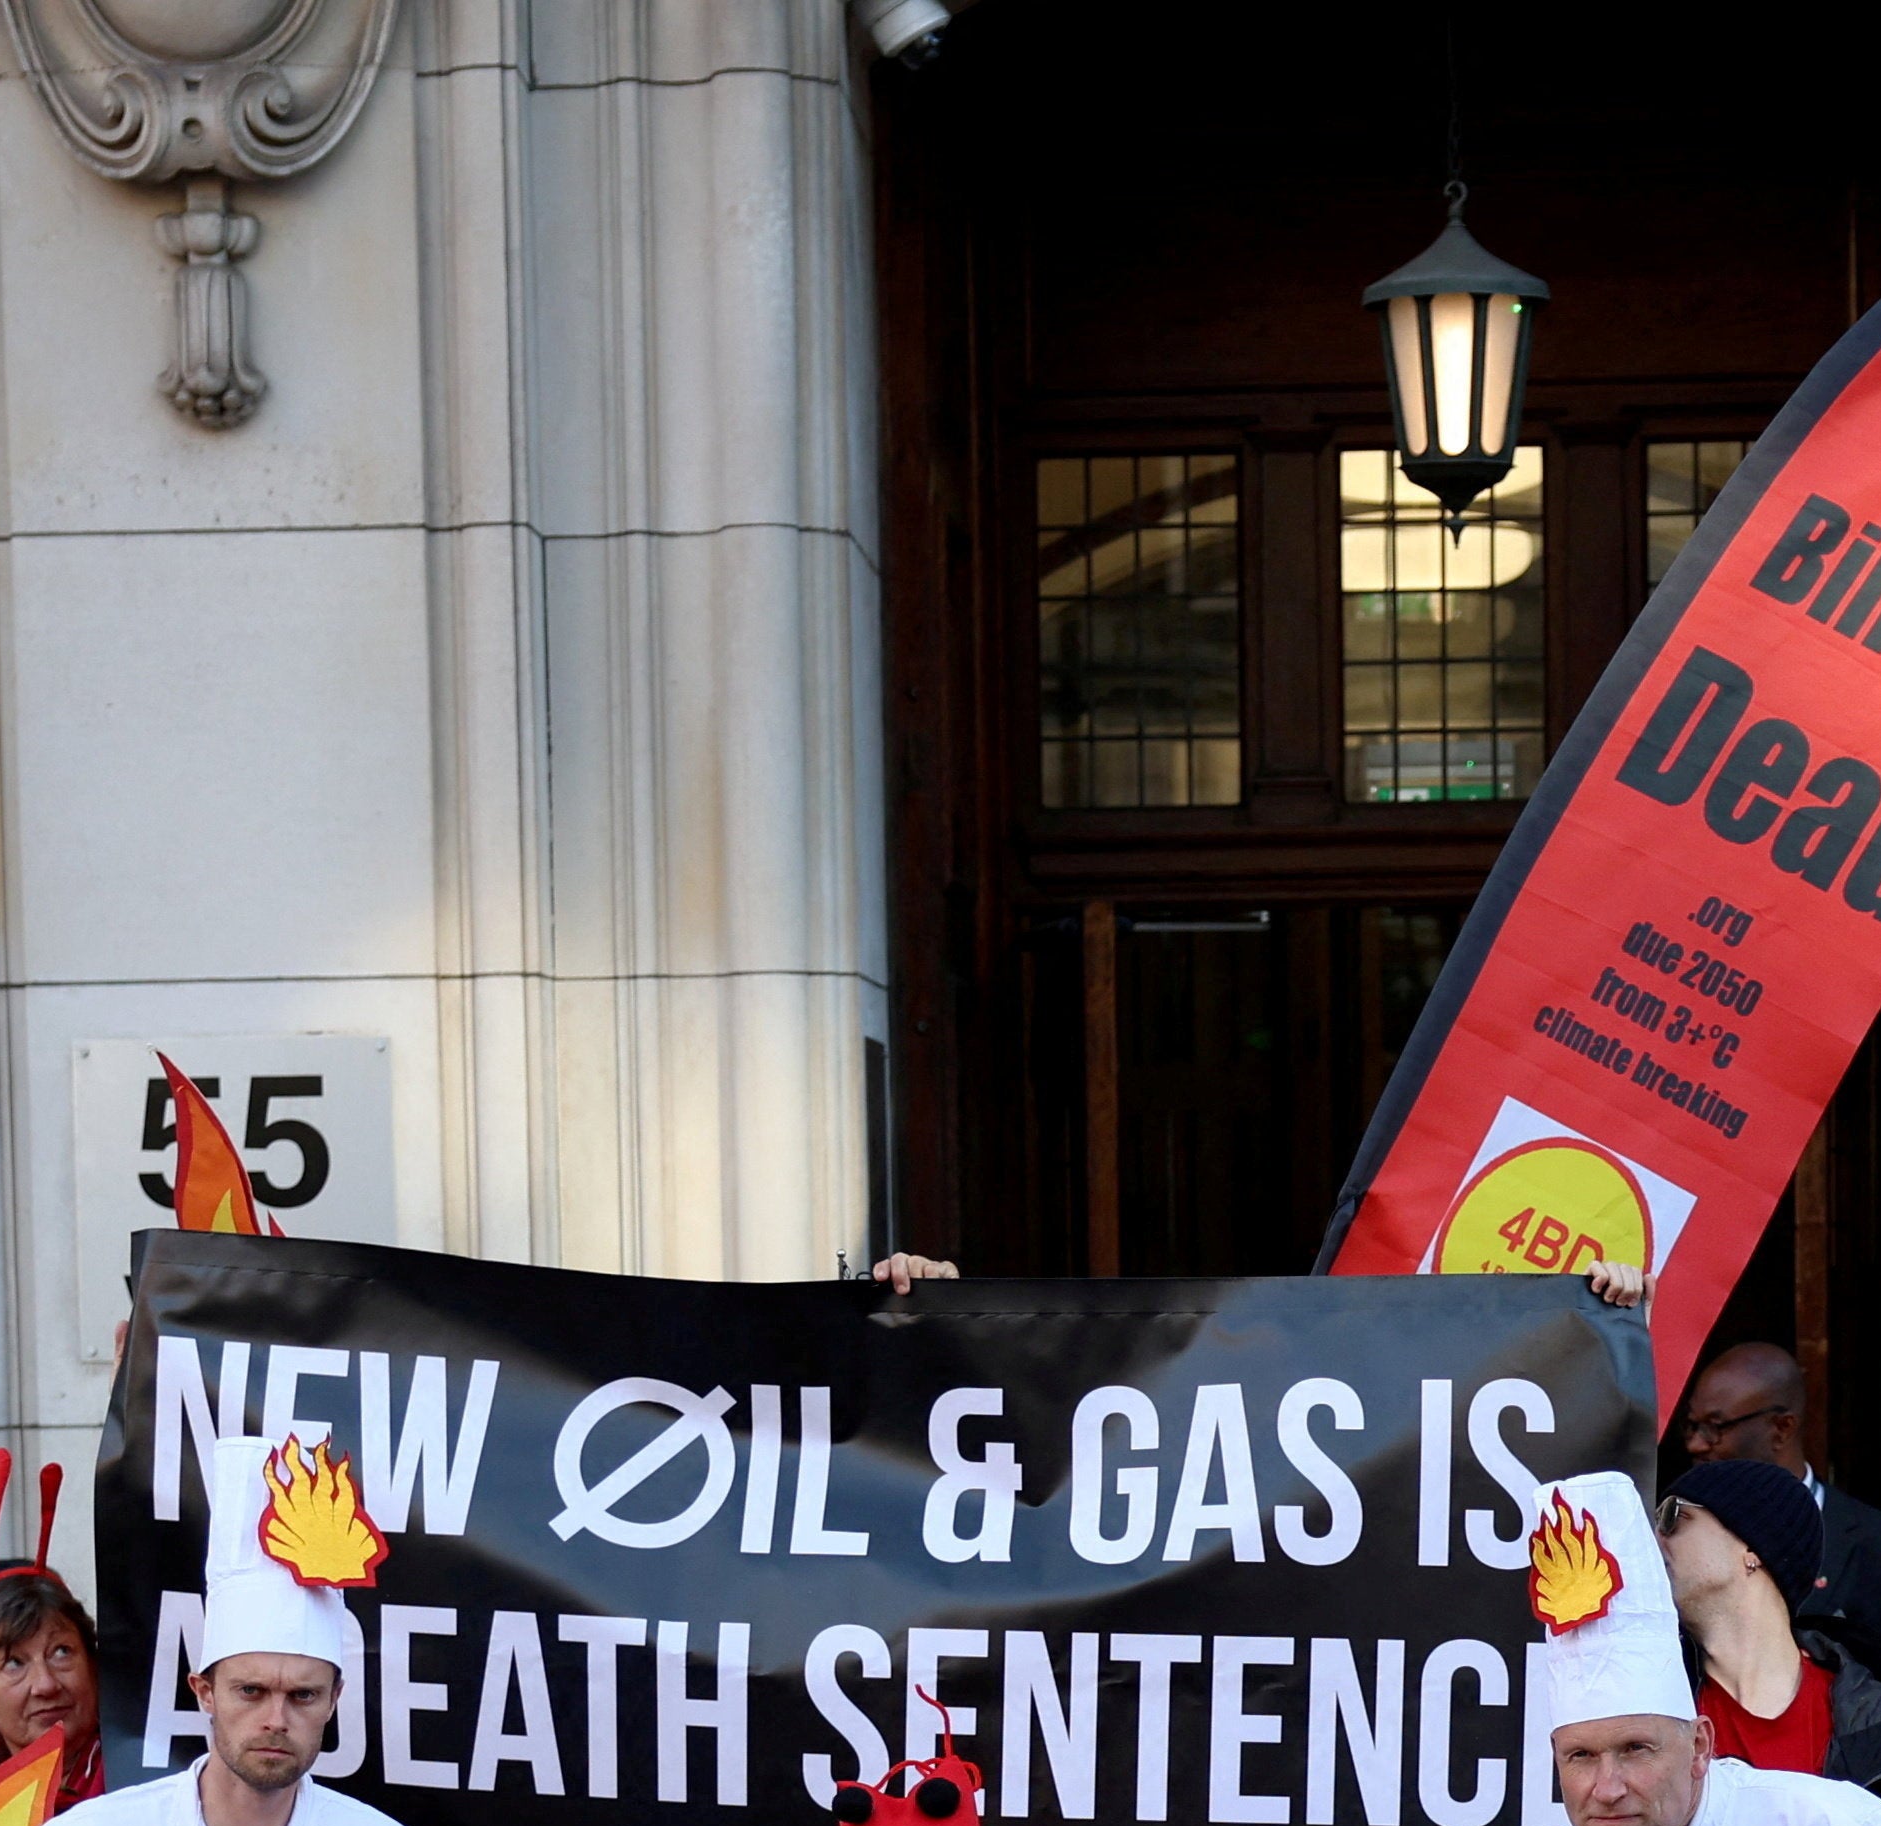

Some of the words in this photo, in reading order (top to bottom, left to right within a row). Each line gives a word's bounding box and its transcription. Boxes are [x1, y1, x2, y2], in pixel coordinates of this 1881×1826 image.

[1621, 921, 1684, 975] due
[1678, 950, 1764, 1017] 2050
[1687, 896, 1754, 947] .org
[1590, 966, 1668, 1032] from
[1533, 1005, 1634, 1075] climate
[1630, 1051, 1749, 1139] breaking
[138, 1075, 331, 1210] 55
[153, 1336, 501, 1536] NEW
[922, 1386, 1024, 1563] &
[1068, 1376, 1366, 1566] GAS
[1417, 1377, 1557, 1570] IS
